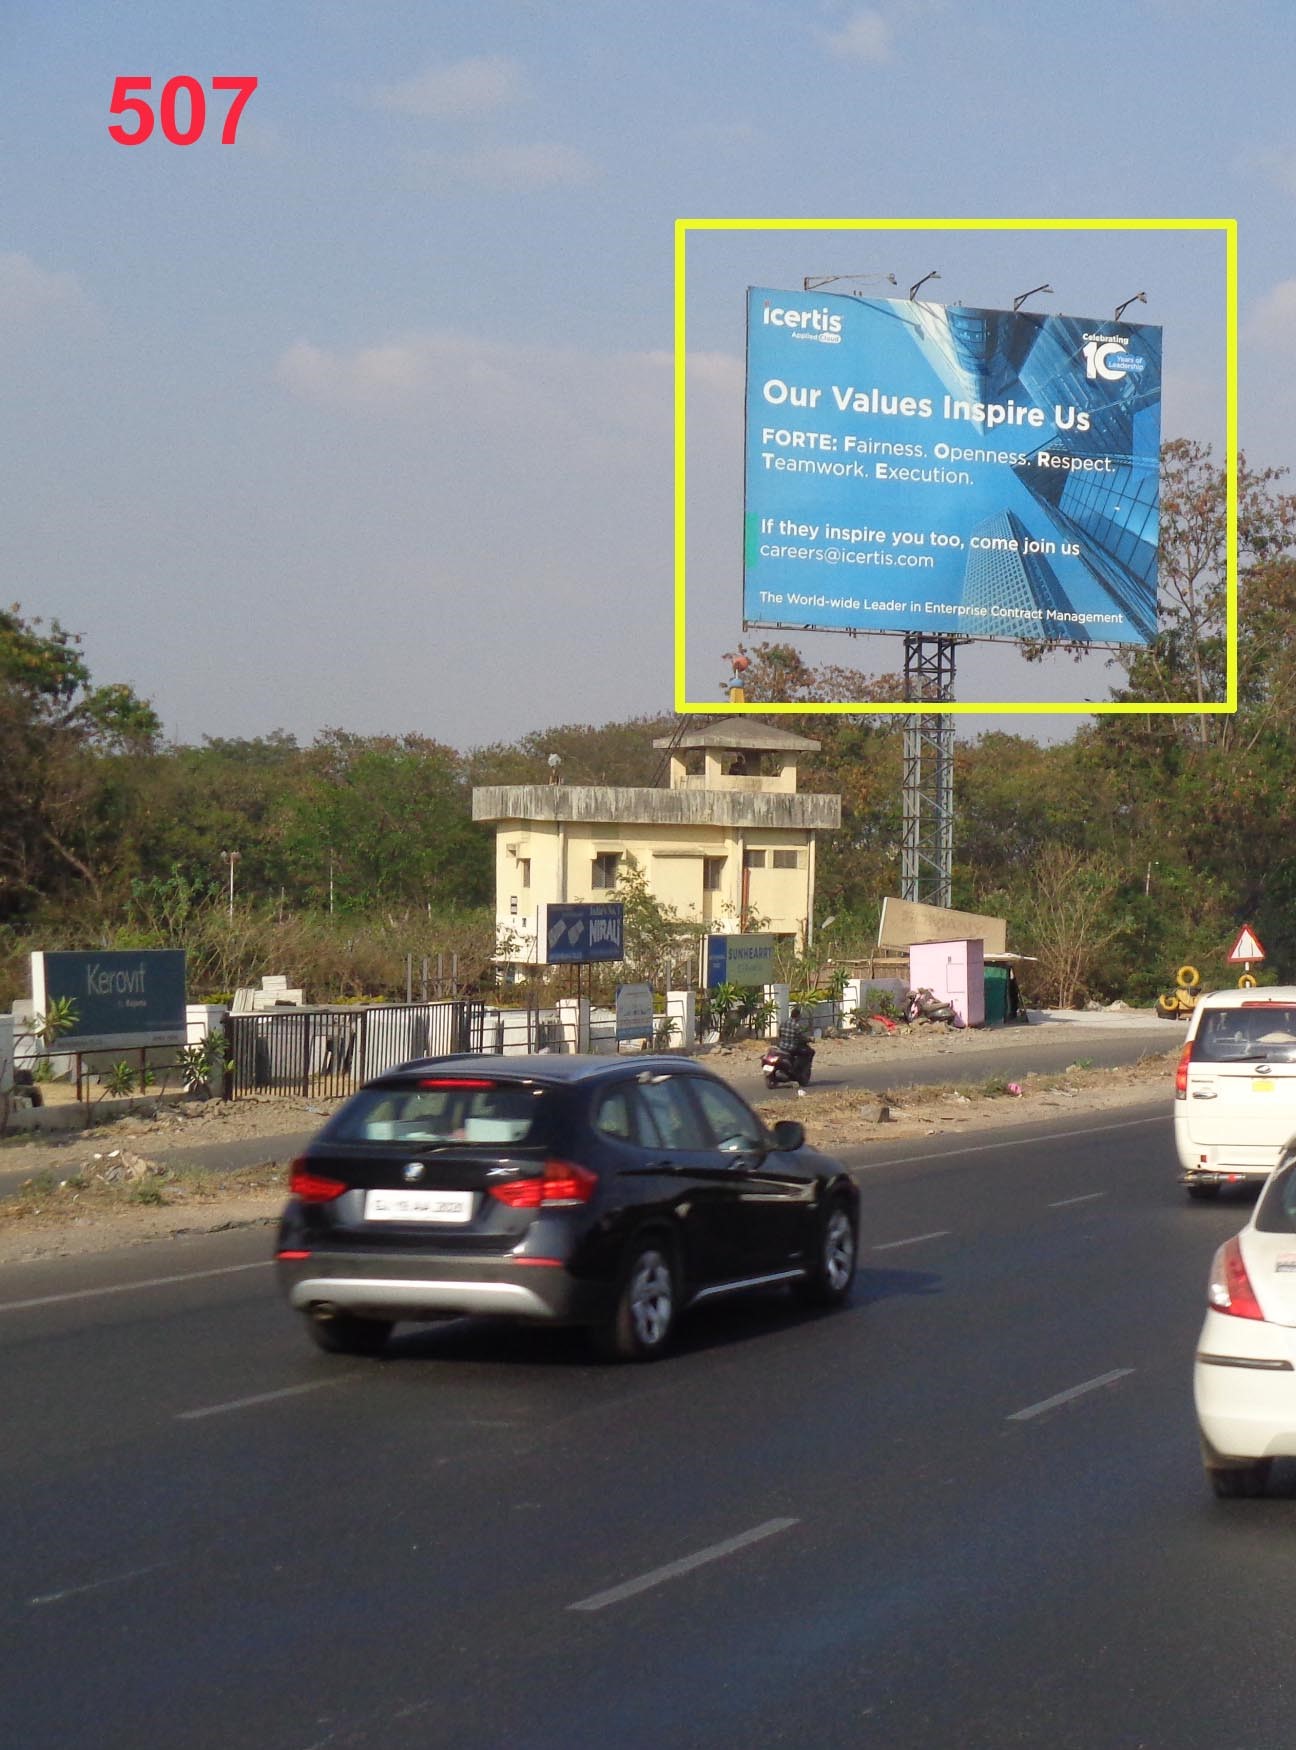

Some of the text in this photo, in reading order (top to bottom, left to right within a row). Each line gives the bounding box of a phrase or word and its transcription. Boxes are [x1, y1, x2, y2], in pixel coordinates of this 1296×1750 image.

[763, 300, 842, 333] icertis
[791, 331, 818, 341] Applied
[1082, 333, 1129, 345] Celebrating
[1107, 361, 1144, 370] Leadership
[1117, 355, 1134, 363] Years
[763, 379, 1091, 431] Our Values Inspire Us
[762, 428, 1117, 473] FORTE: Fairness. Openness. Respect.
[762, 453, 975, 485] Teamwork. Execution.
[761, 518, 1080, 556] If they inspire you too, come join us
[760, 544, 934, 568] careers@icertis.com
[760, 591, 1124, 625] The World-wide Leader in Enterprise Contract Management
[86, 961, 146, 995] Kerovit
